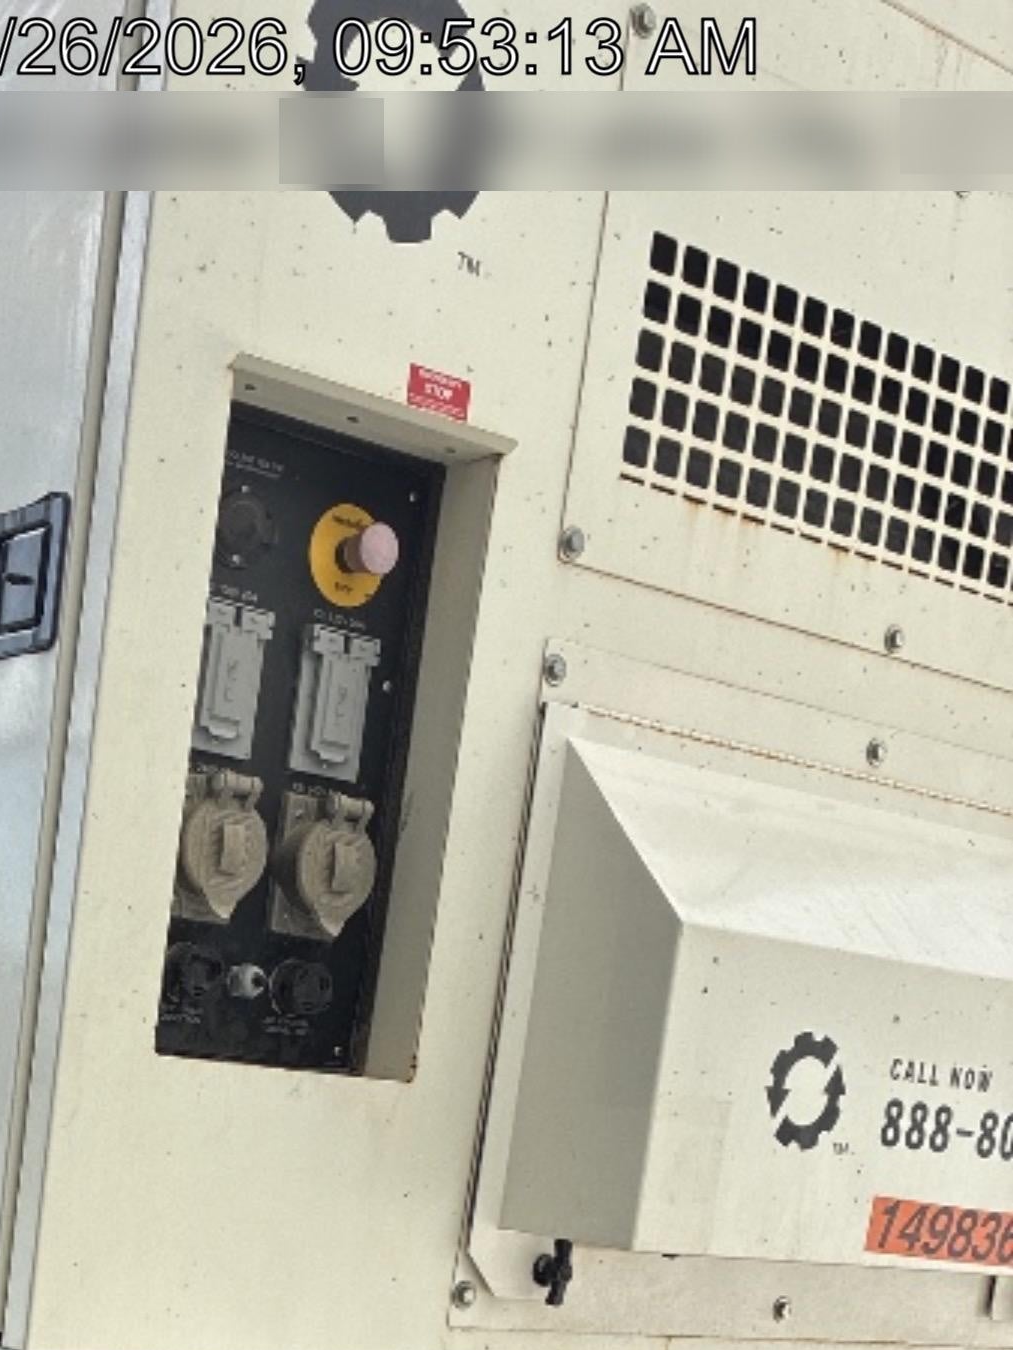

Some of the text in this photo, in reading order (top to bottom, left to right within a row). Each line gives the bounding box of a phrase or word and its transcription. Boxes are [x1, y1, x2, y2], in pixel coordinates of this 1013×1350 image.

[890, 1058, 993, 1092] CALL NOW
[878, 1199, 1013, 1263] 149836
